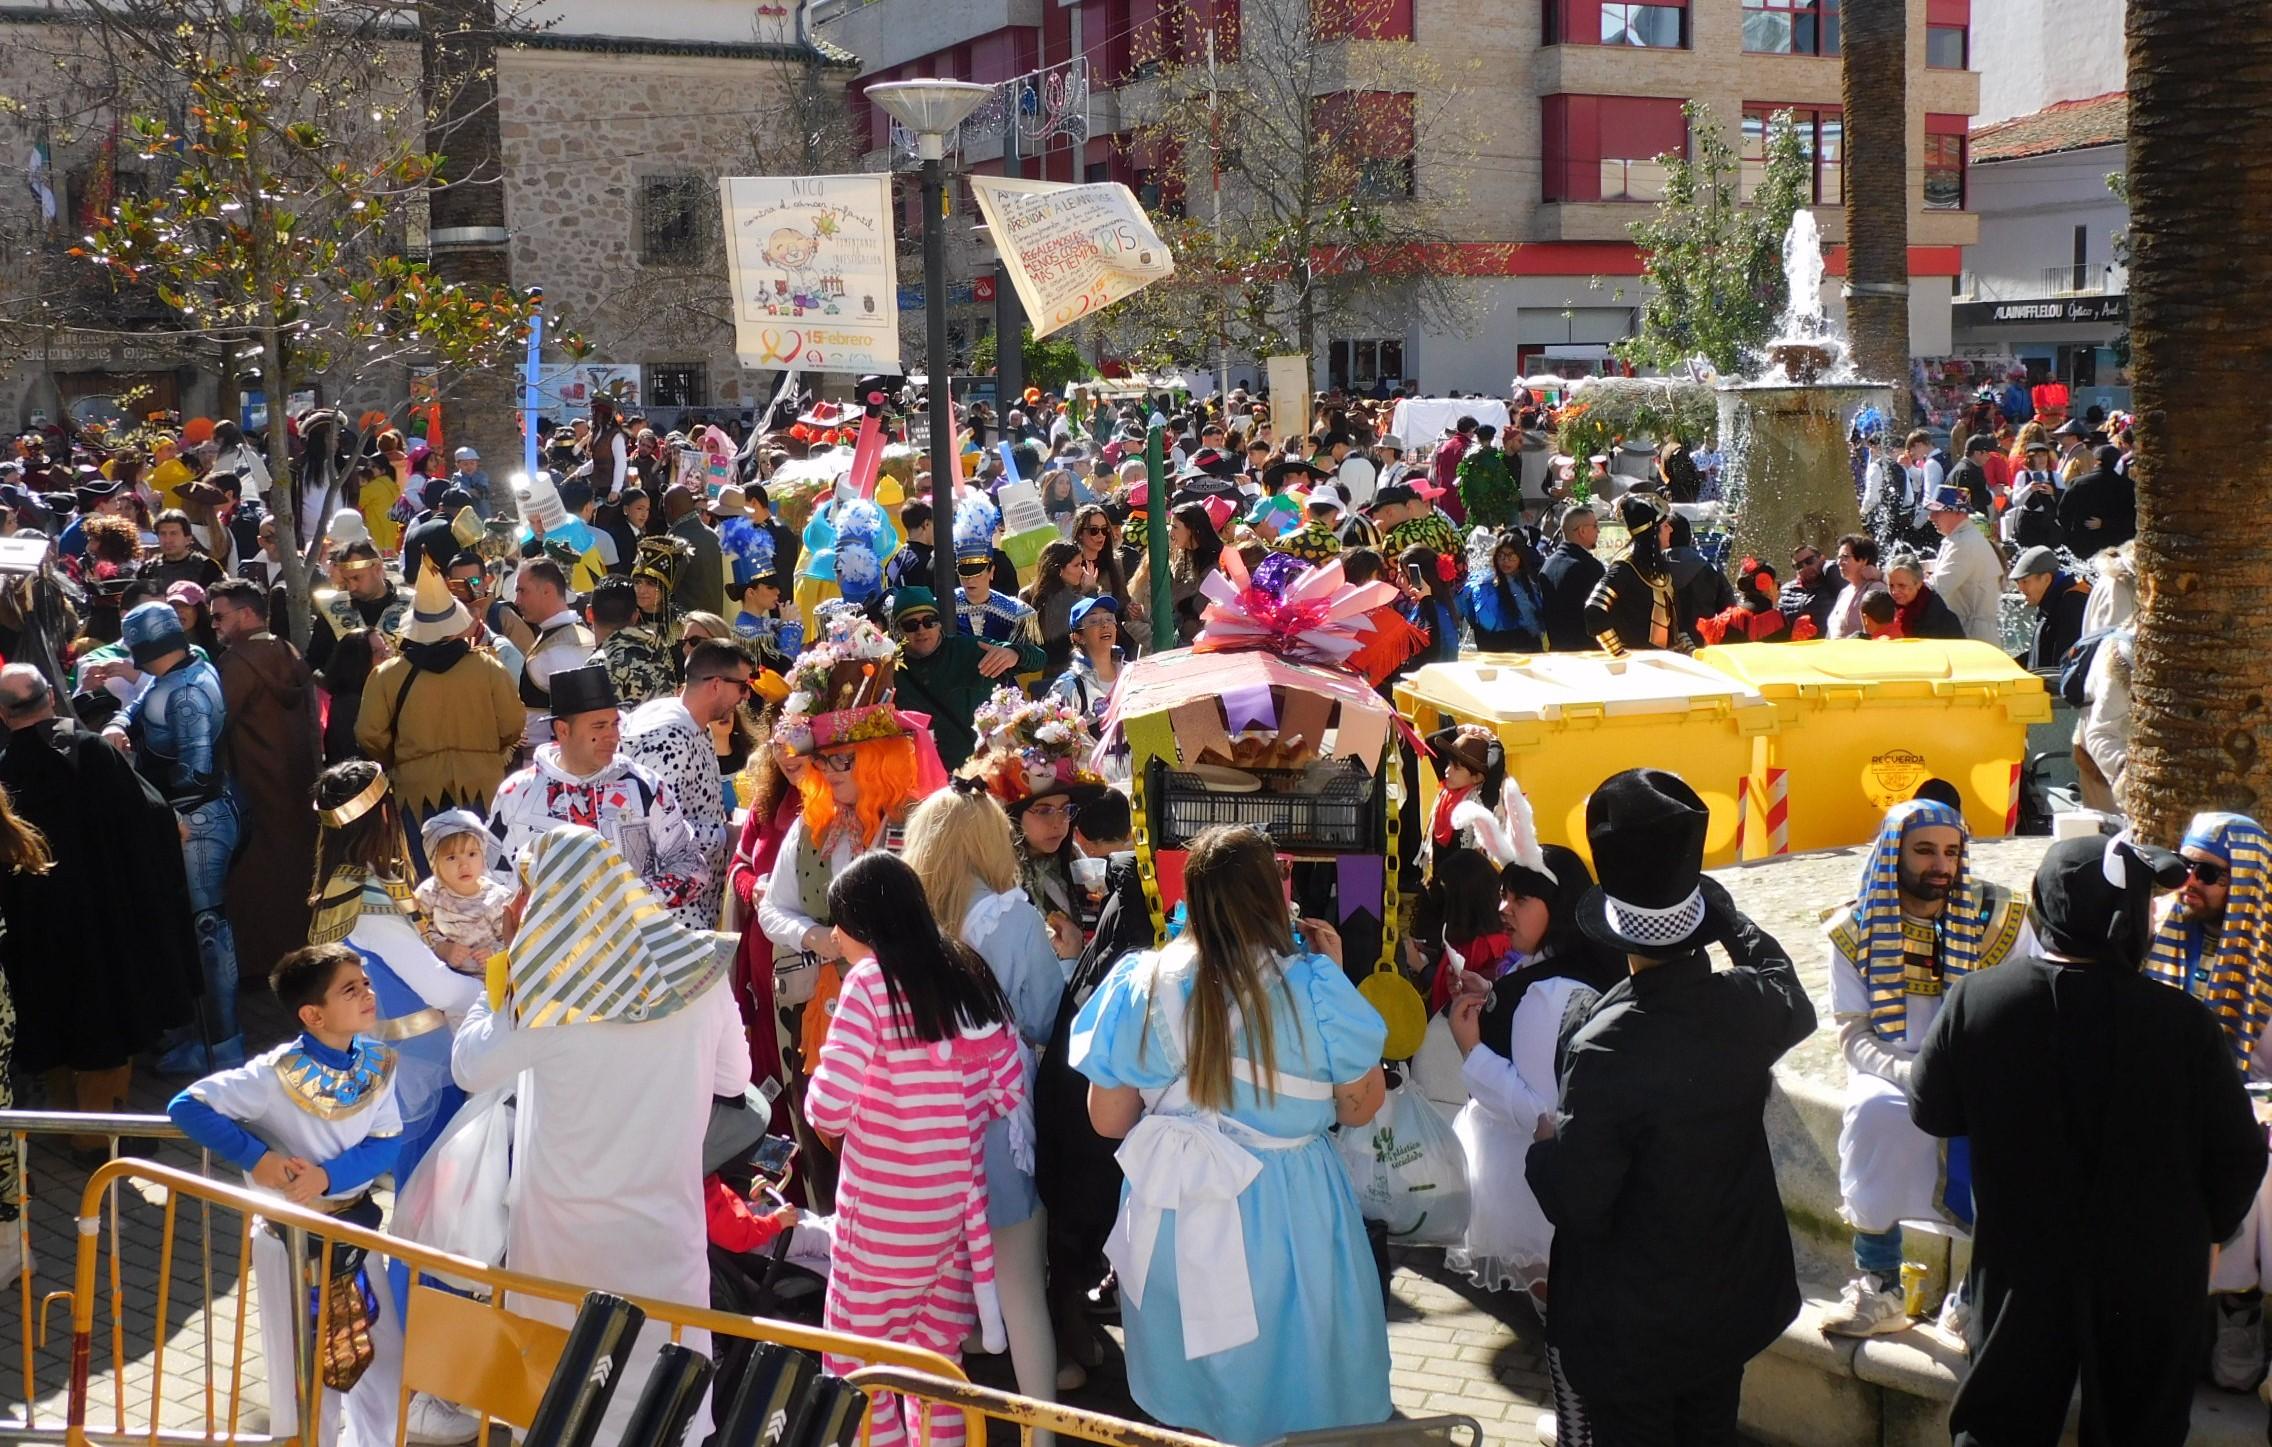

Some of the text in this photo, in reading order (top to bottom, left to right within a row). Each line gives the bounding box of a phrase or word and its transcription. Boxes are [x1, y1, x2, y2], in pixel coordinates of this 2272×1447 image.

[792, 178, 824, 197] NICO
[1024, 252, 1059, 274] MENOS
[1055, 245, 1099, 273] TIEMPO
[1872, 755, 1925, 764] RECUERDA
